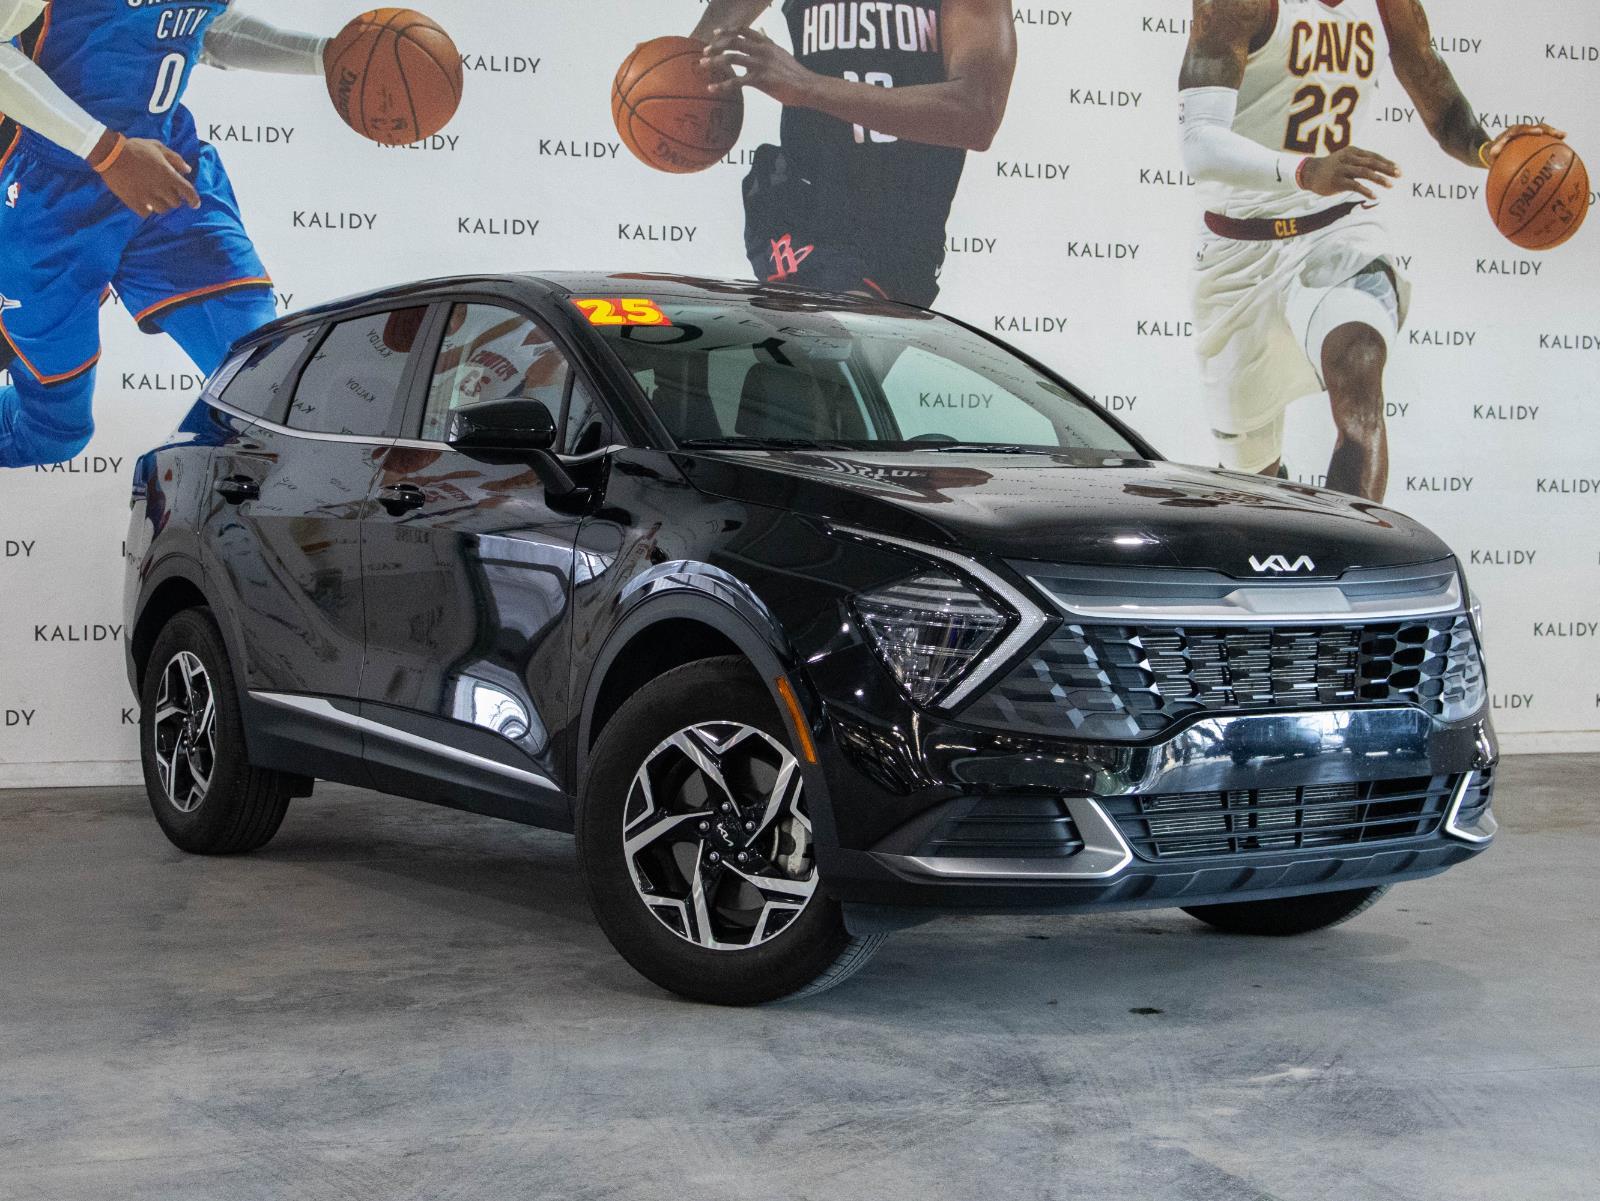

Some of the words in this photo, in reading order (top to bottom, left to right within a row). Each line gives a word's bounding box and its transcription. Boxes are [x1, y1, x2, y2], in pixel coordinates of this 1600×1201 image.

[157, 8, 208, 39] CITY
[1013, 9, 1072, 26] ALIDY
[1142, 16, 1193, 34] KALI
[802, 2, 938, 55] HOUSTON
[1288, 20, 1375, 79] CAVS
[1429, 36, 1482, 54] ALIDY
[1545, 43, 1600, 61] KALID
[459, 54, 541, 74] KALIDY
[148, 53, 186, 114] 0
[1069, 88, 1142, 107] KALIDY
[1283, 84, 1360, 155] 23
[1375, 107, 1415, 123] IDY
[209, 124, 295, 145] KALIDY
[539, 139, 620, 159] KALIDY
[996, 161, 1070, 180] KALIDY
[1412, 182, 1479, 200] KALIDY
[293, 210, 377, 230] KALIDY
[458, 216, 540, 236] KALIDY
[1274, 219, 1298, 238] CLE
[618, 223, 697, 243] KALIDY
[944, 236, 997, 254] LIDY
[1067, 241, 1140, 260] KALIDY
[1476, 258, 1542, 276] KALIDY
[576, 299, 663, 325] 25
[994, 316, 1067, 333] KALIDY
[1136, 320, 1193, 337] KALID
[1409, 329, 1476, 347] KALIDY
[122, 373, 207, 391] KALIDY
[919, 392, 993, 409] KALIDY
[1473, 404, 1540, 421] KALIDY
[1406, 476, 1473, 492] KALIDY
[1536, 478, 1600, 494] KALIDY
[1470, 549, 1537, 565] KALIDY
[34, 624, 123, 642] KALIDY
[1533, 621, 1599, 637] KALIDY
[1492, 693, 1534, 709] LIDY
